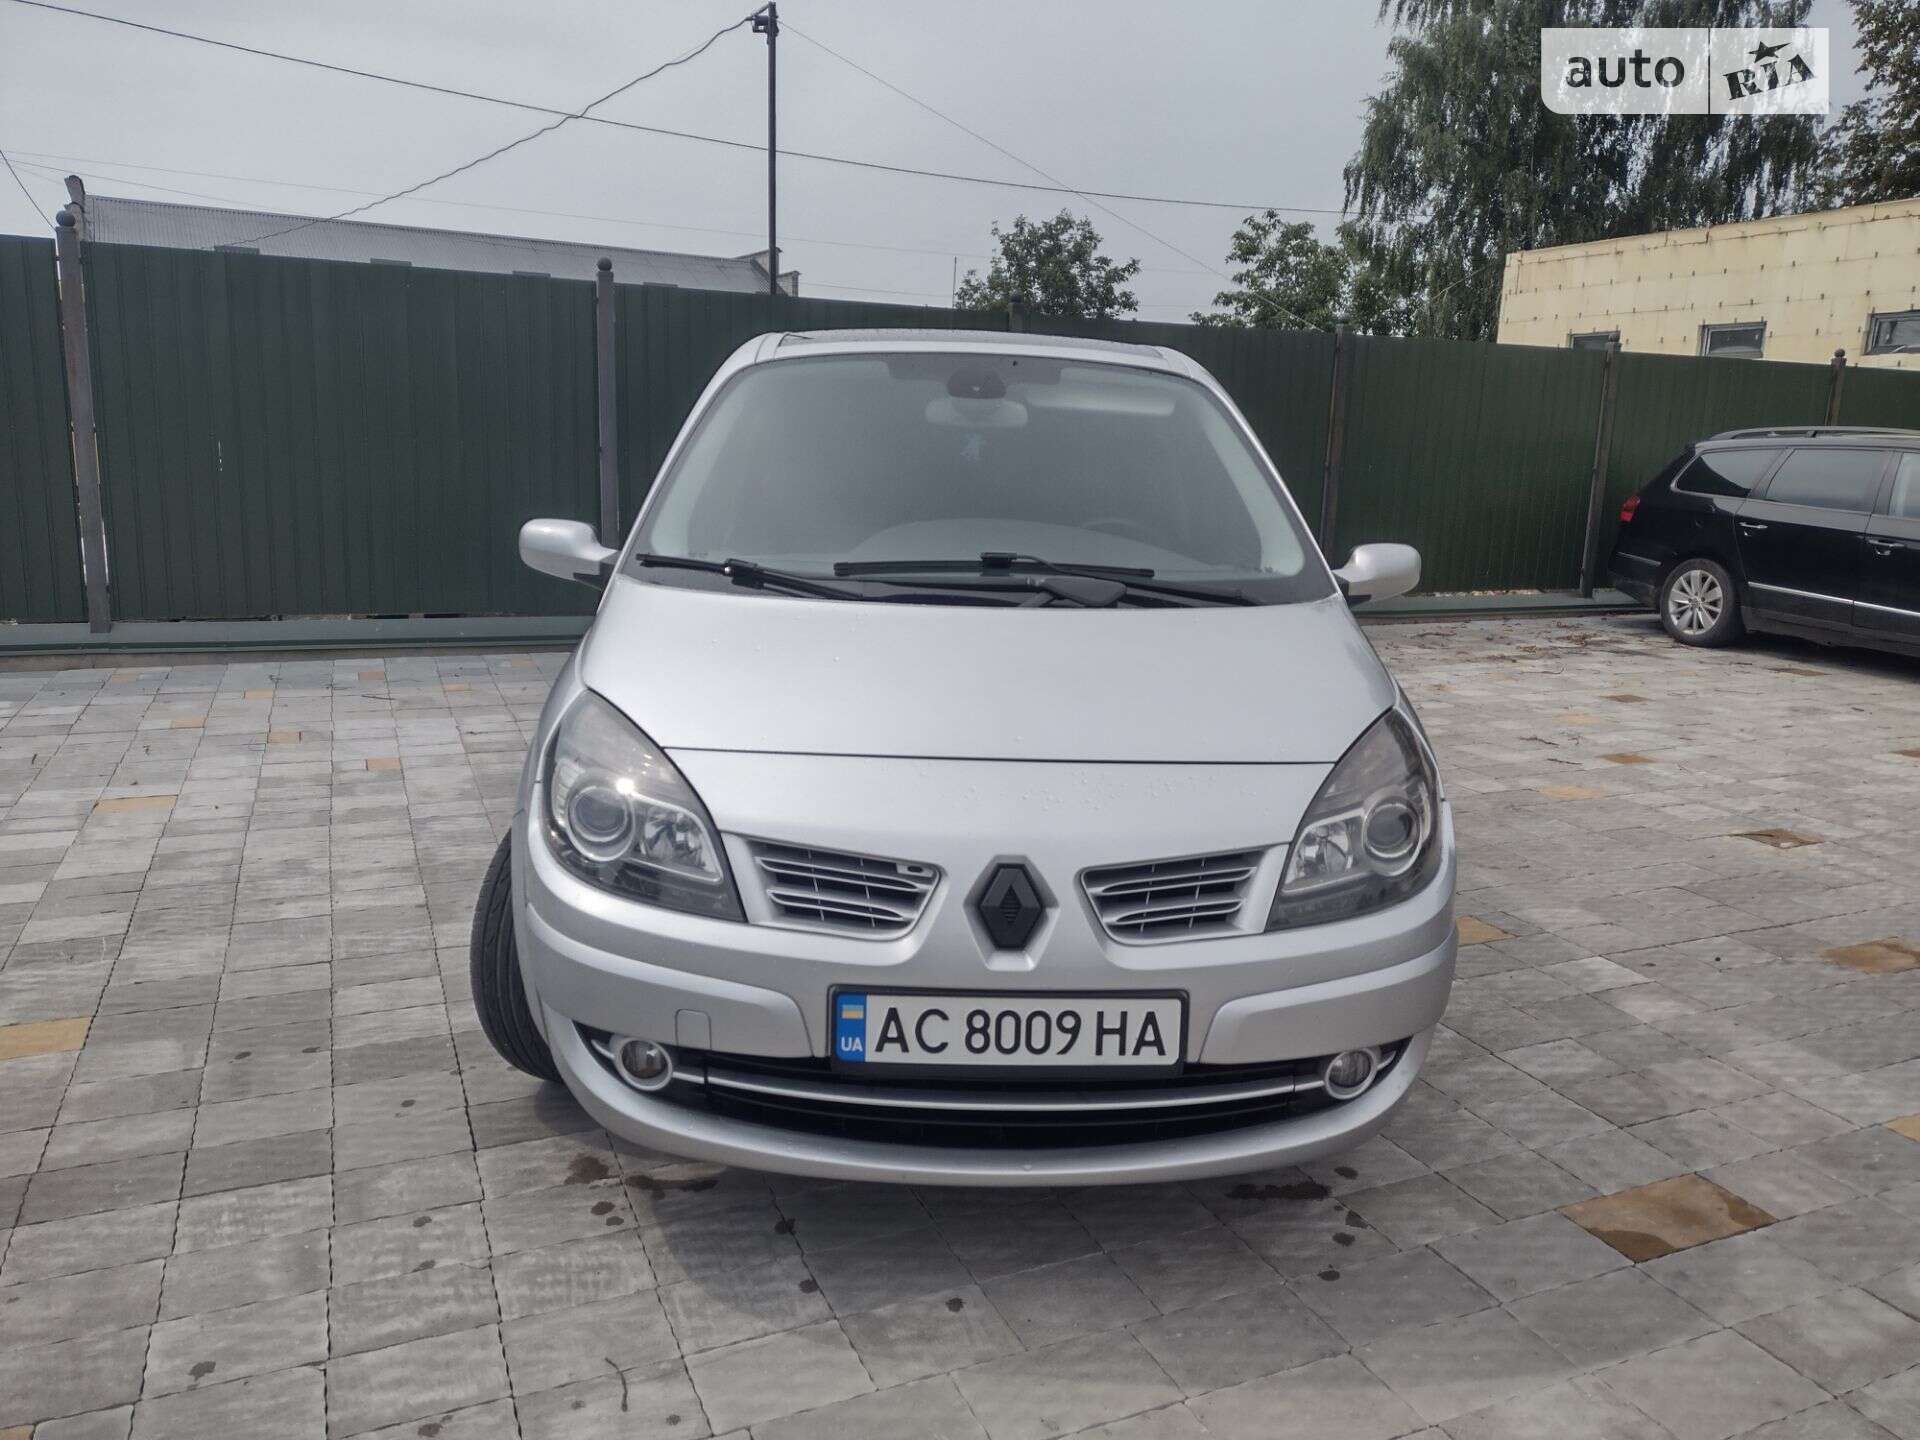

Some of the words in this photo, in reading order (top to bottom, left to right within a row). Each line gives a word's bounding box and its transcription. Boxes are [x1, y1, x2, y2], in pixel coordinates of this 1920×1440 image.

[841, 1036, 863, 1053] UA
[874, 1007, 950, 1054] AC
[964, 1009, 1082, 1056] 8009
[1094, 1010, 1167, 1057] HA
